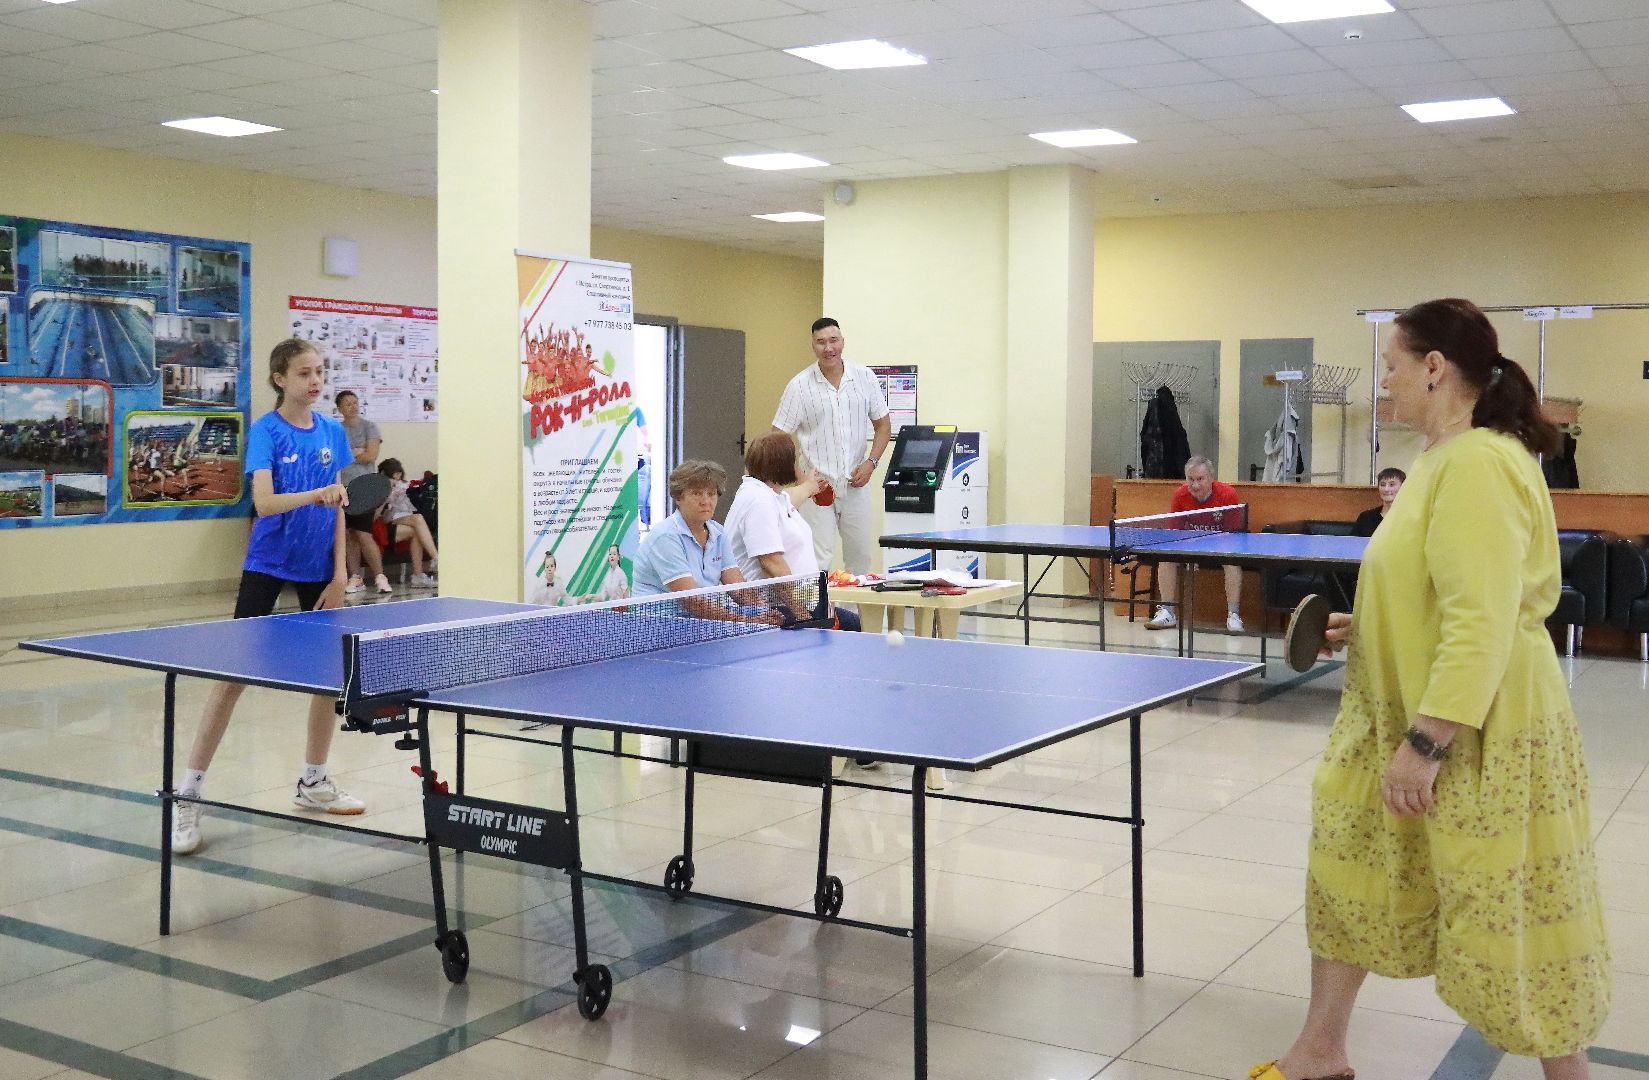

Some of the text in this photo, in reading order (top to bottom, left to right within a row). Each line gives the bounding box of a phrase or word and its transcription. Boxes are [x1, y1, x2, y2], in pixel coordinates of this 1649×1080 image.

[624, 322, 632, 331] 03
[530, 382, 632, 440] РОК-Н-РОЛЛ
[448, 804, 544, 836] START LINE
[480, 834, 518, 854] OLYMPIC
